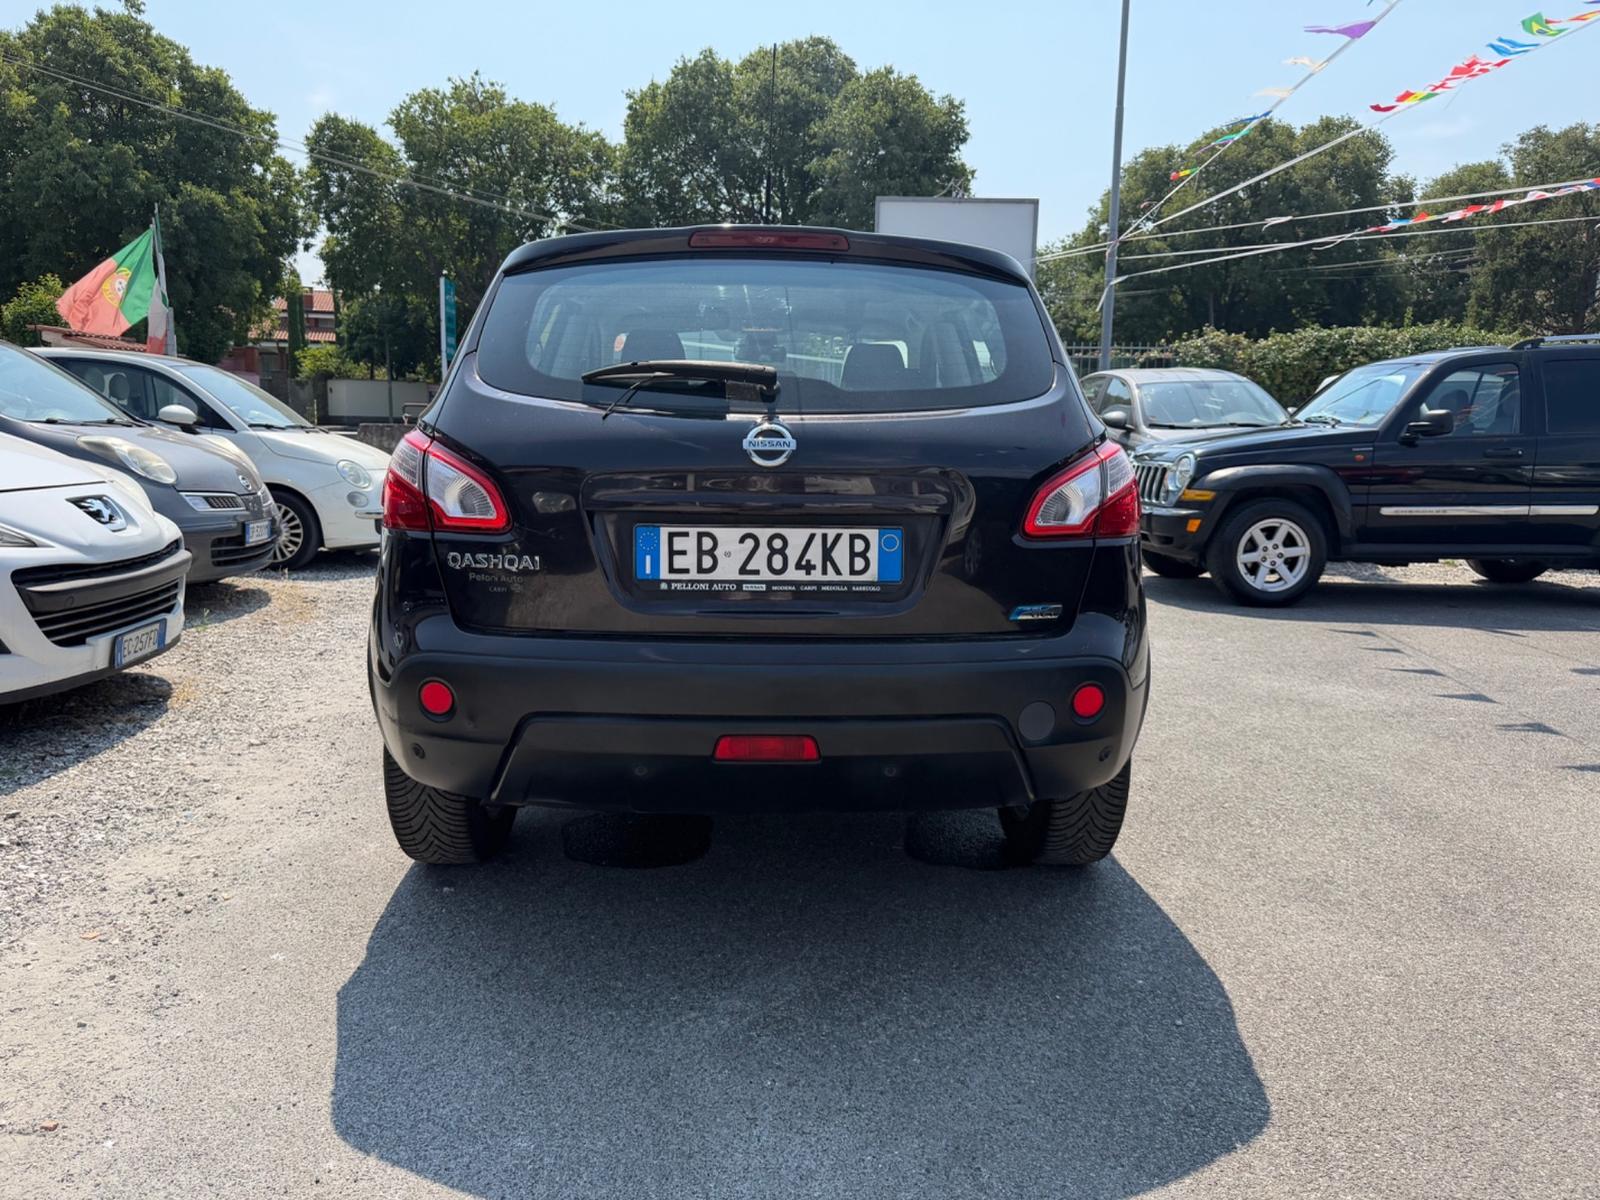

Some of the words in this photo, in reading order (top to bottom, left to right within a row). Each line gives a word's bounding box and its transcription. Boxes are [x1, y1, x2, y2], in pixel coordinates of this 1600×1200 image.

[748, 440, 791, 448] NISSAN
[666, 531, 719, 575] EB
[737, 532, 872, 577] 284KB
[446, 551, 541, 572] QASHQAI
[500, 575, 525, 585] Auto
[671, 582, 710, 591] PELLONI
[711, 583, 737, 591] AUTO
